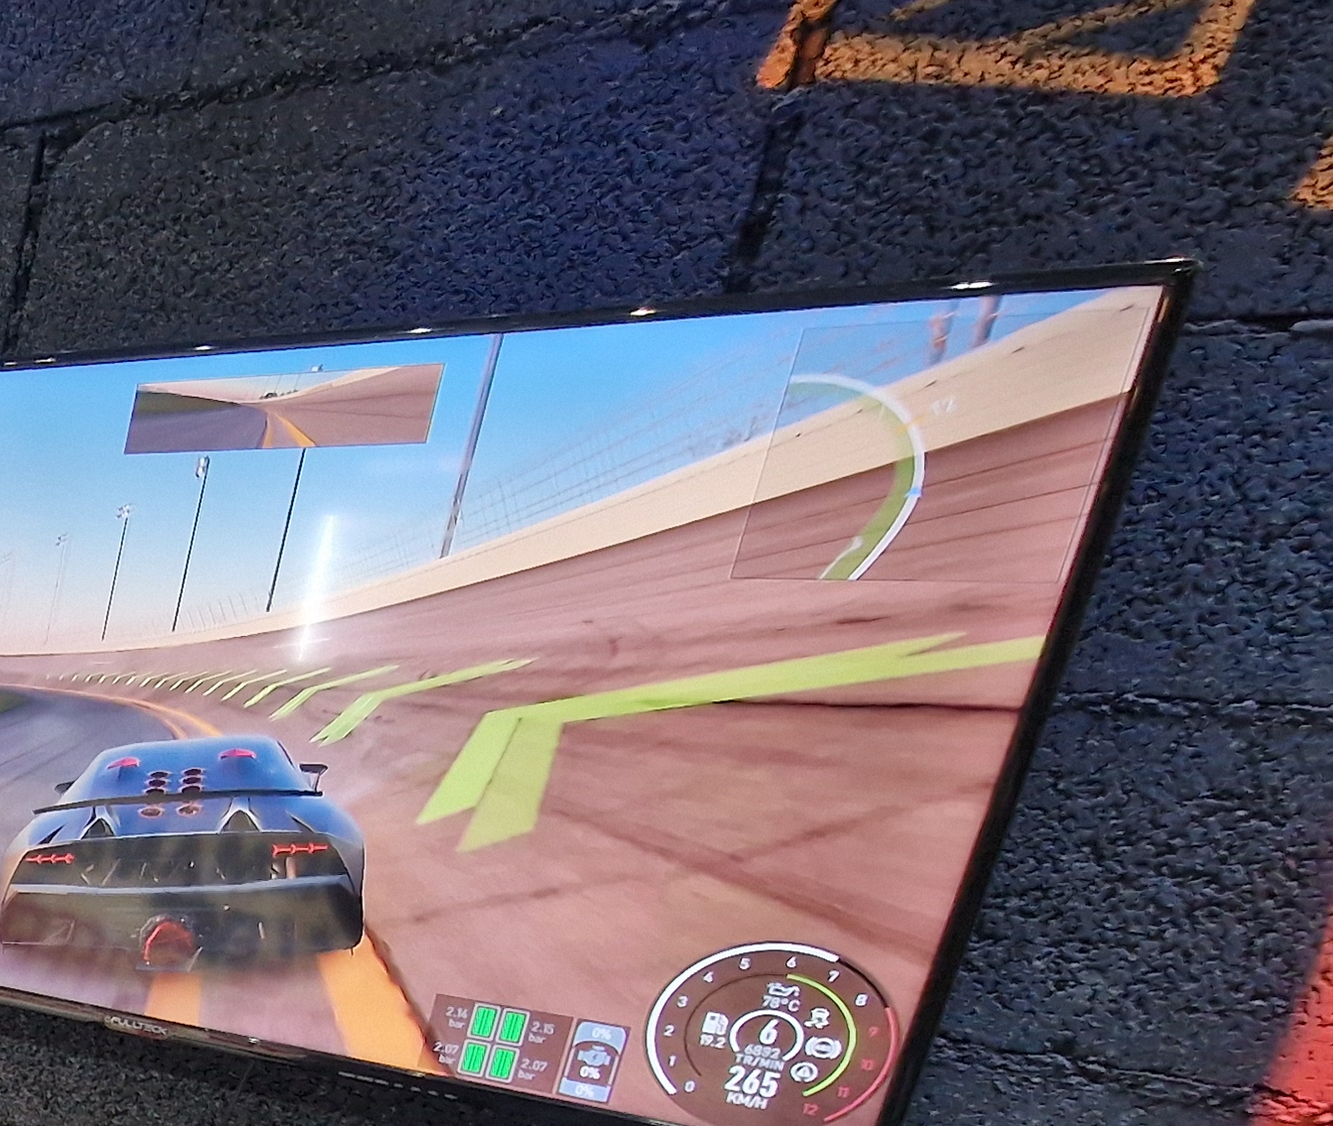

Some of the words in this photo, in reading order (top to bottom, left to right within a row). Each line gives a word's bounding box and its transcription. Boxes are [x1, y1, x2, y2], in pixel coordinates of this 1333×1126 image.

[739, 957, 751, 970] 5
[786, 956, 797, 968] 6
[703, 971, 714, 983] 4
[828, 970, 839, 982] 7
[677, 996, 688, 1007] 3
[855, 994, 868, 1006] 8
[448, 1018, 466, 1029] bar
[592, 1027, 612, 1040] 0%
[663, 1026, 674, 1037] 2
[759, 1019, 780, 1045] 6
[528, 1033, 546, 1044] bar
[699, 1035, 726, 1049] 19.2
[438, 1054, 456, 1065] bar
[669, 1056, 676, 1067] 1
[517, 1070, 535, 1081] bar
[580, 1066, 601, 1080] 0%
[684, 1081, 696, 1093] 0
[724, 1065, 781, 1098] 265
[575, 1084, 595, 1097] 0%
[726, 1091, 769, 1109] KM/H
[803, 1104, 819, 1116] 12
